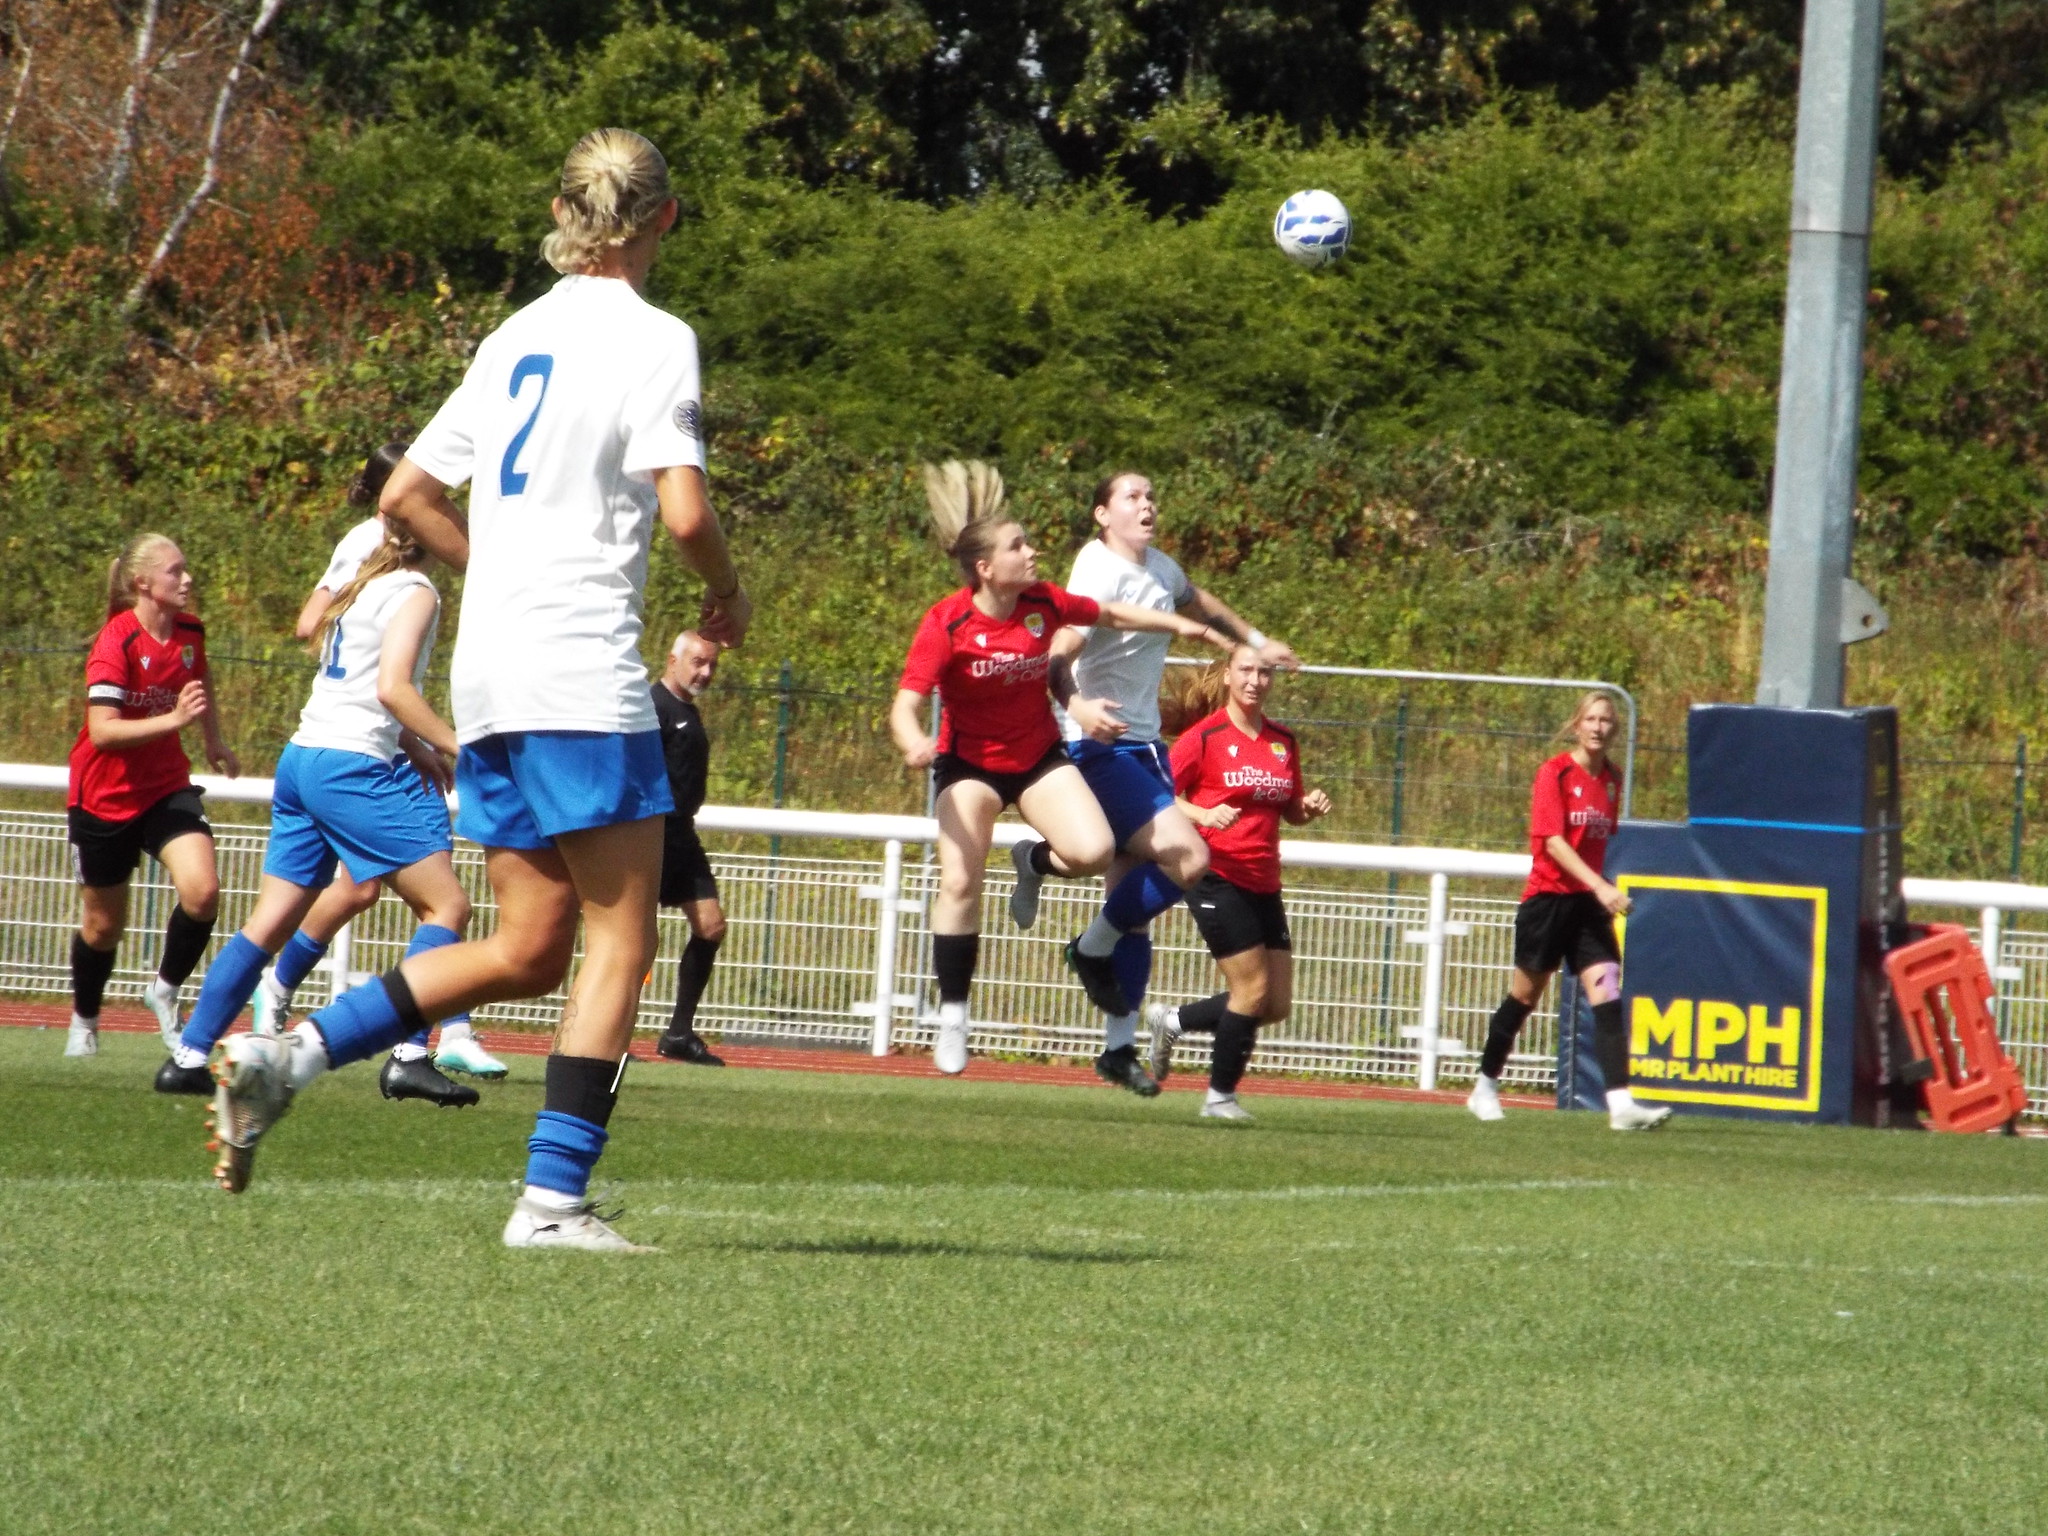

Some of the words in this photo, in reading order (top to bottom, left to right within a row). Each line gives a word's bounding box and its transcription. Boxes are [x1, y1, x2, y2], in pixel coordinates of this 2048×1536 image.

[500, 353, 554, 497] 2
[1242, 766, 1263, 776] The
[1630, 997, 1801, 1066] MPH
[1629, 1058, 1666, 1079] MR
[1667, 1060, 1744, 1084] PLANT
[1744, 1066, 1798, 1088] HIRE
